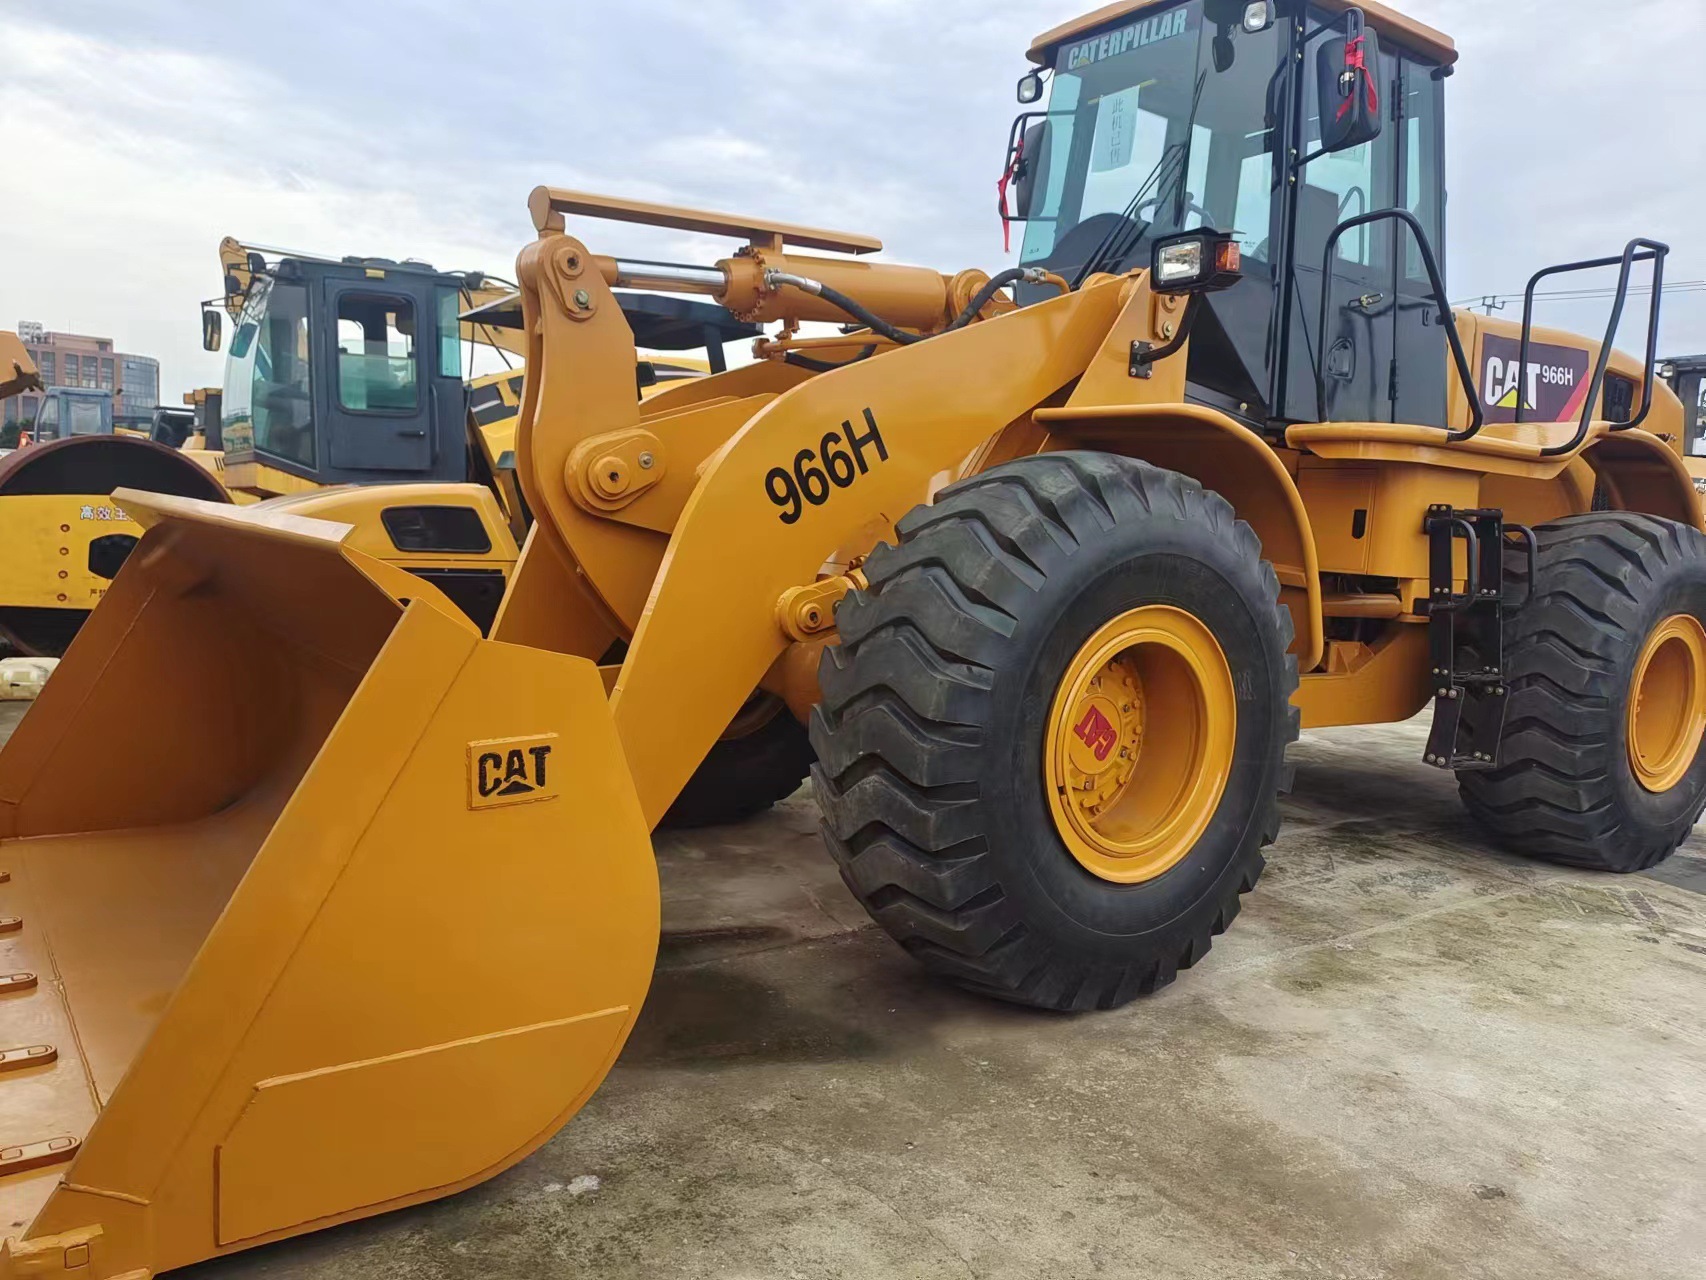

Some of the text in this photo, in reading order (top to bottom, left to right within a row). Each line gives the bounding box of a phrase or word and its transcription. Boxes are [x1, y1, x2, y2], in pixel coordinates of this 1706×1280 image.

[1068, 9, 1187, 70] CATERPILLAR
[1485, 356, 1573, 410] CAT 966H
[765, 407, 889, 524] 966H
[1074, 704, 1117, 761] CAT
[478, 745, 551, 798] CAT
